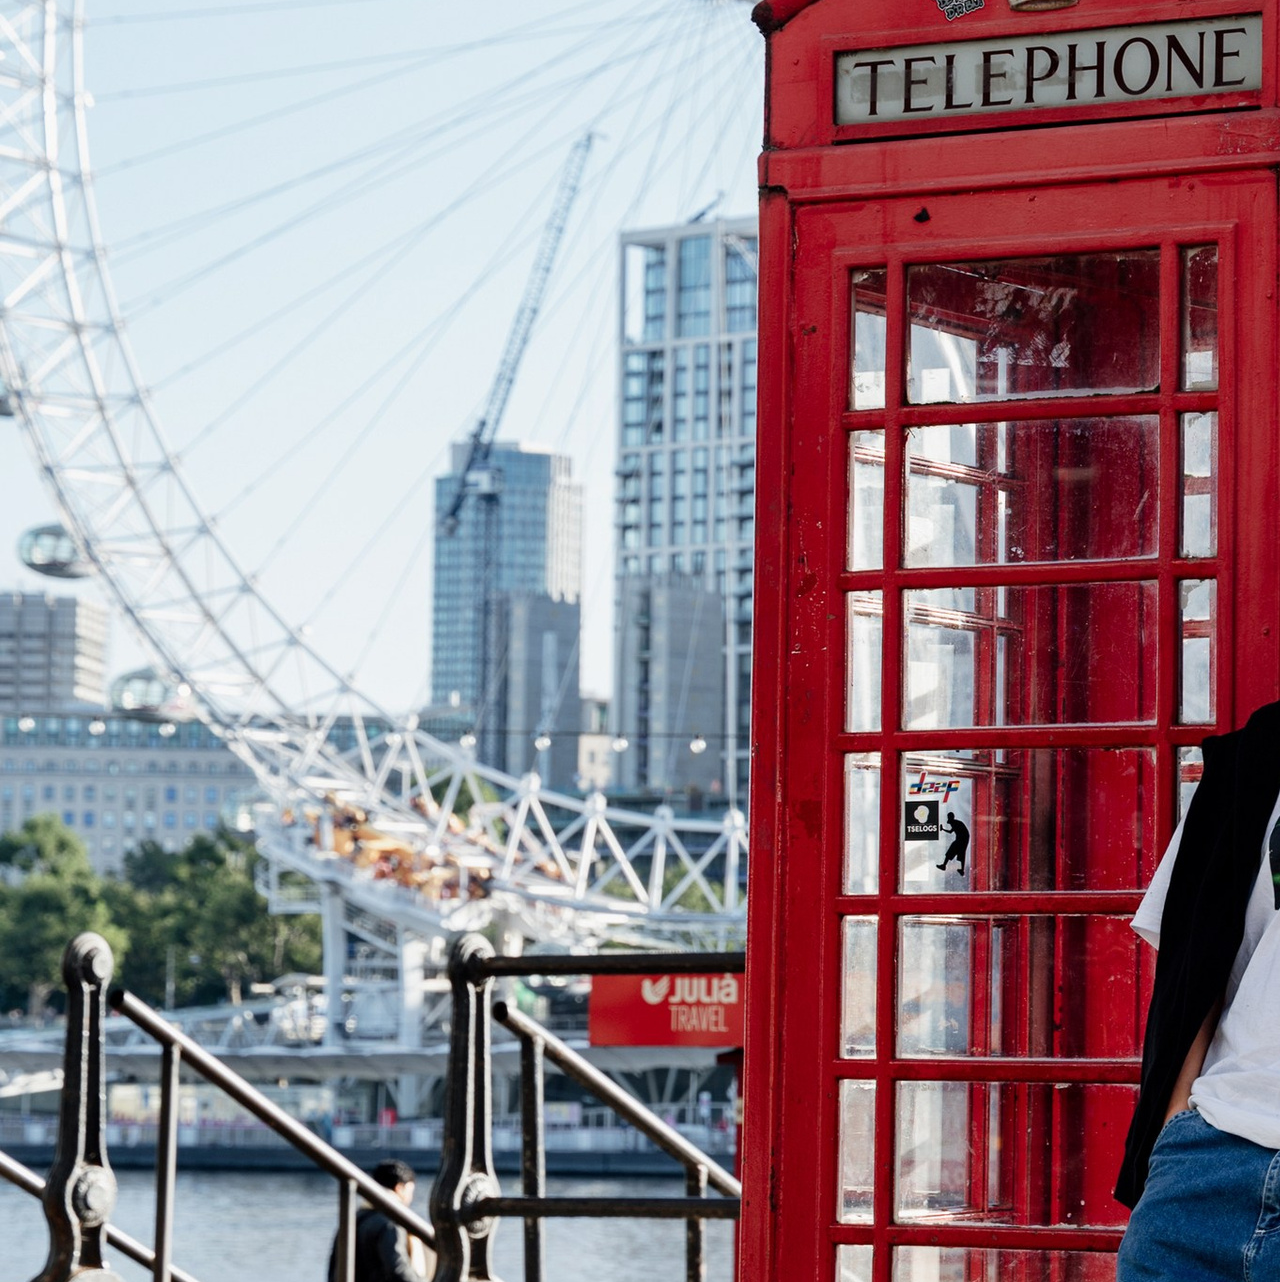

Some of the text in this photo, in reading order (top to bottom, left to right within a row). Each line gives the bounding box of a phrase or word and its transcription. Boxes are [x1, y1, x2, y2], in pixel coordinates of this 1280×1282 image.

[853, 27, 1247, 116] TELEPHONE
[907, 825, 937, 833] TSELOGS
[668, 1005, 729, 1032] TRAVEL
